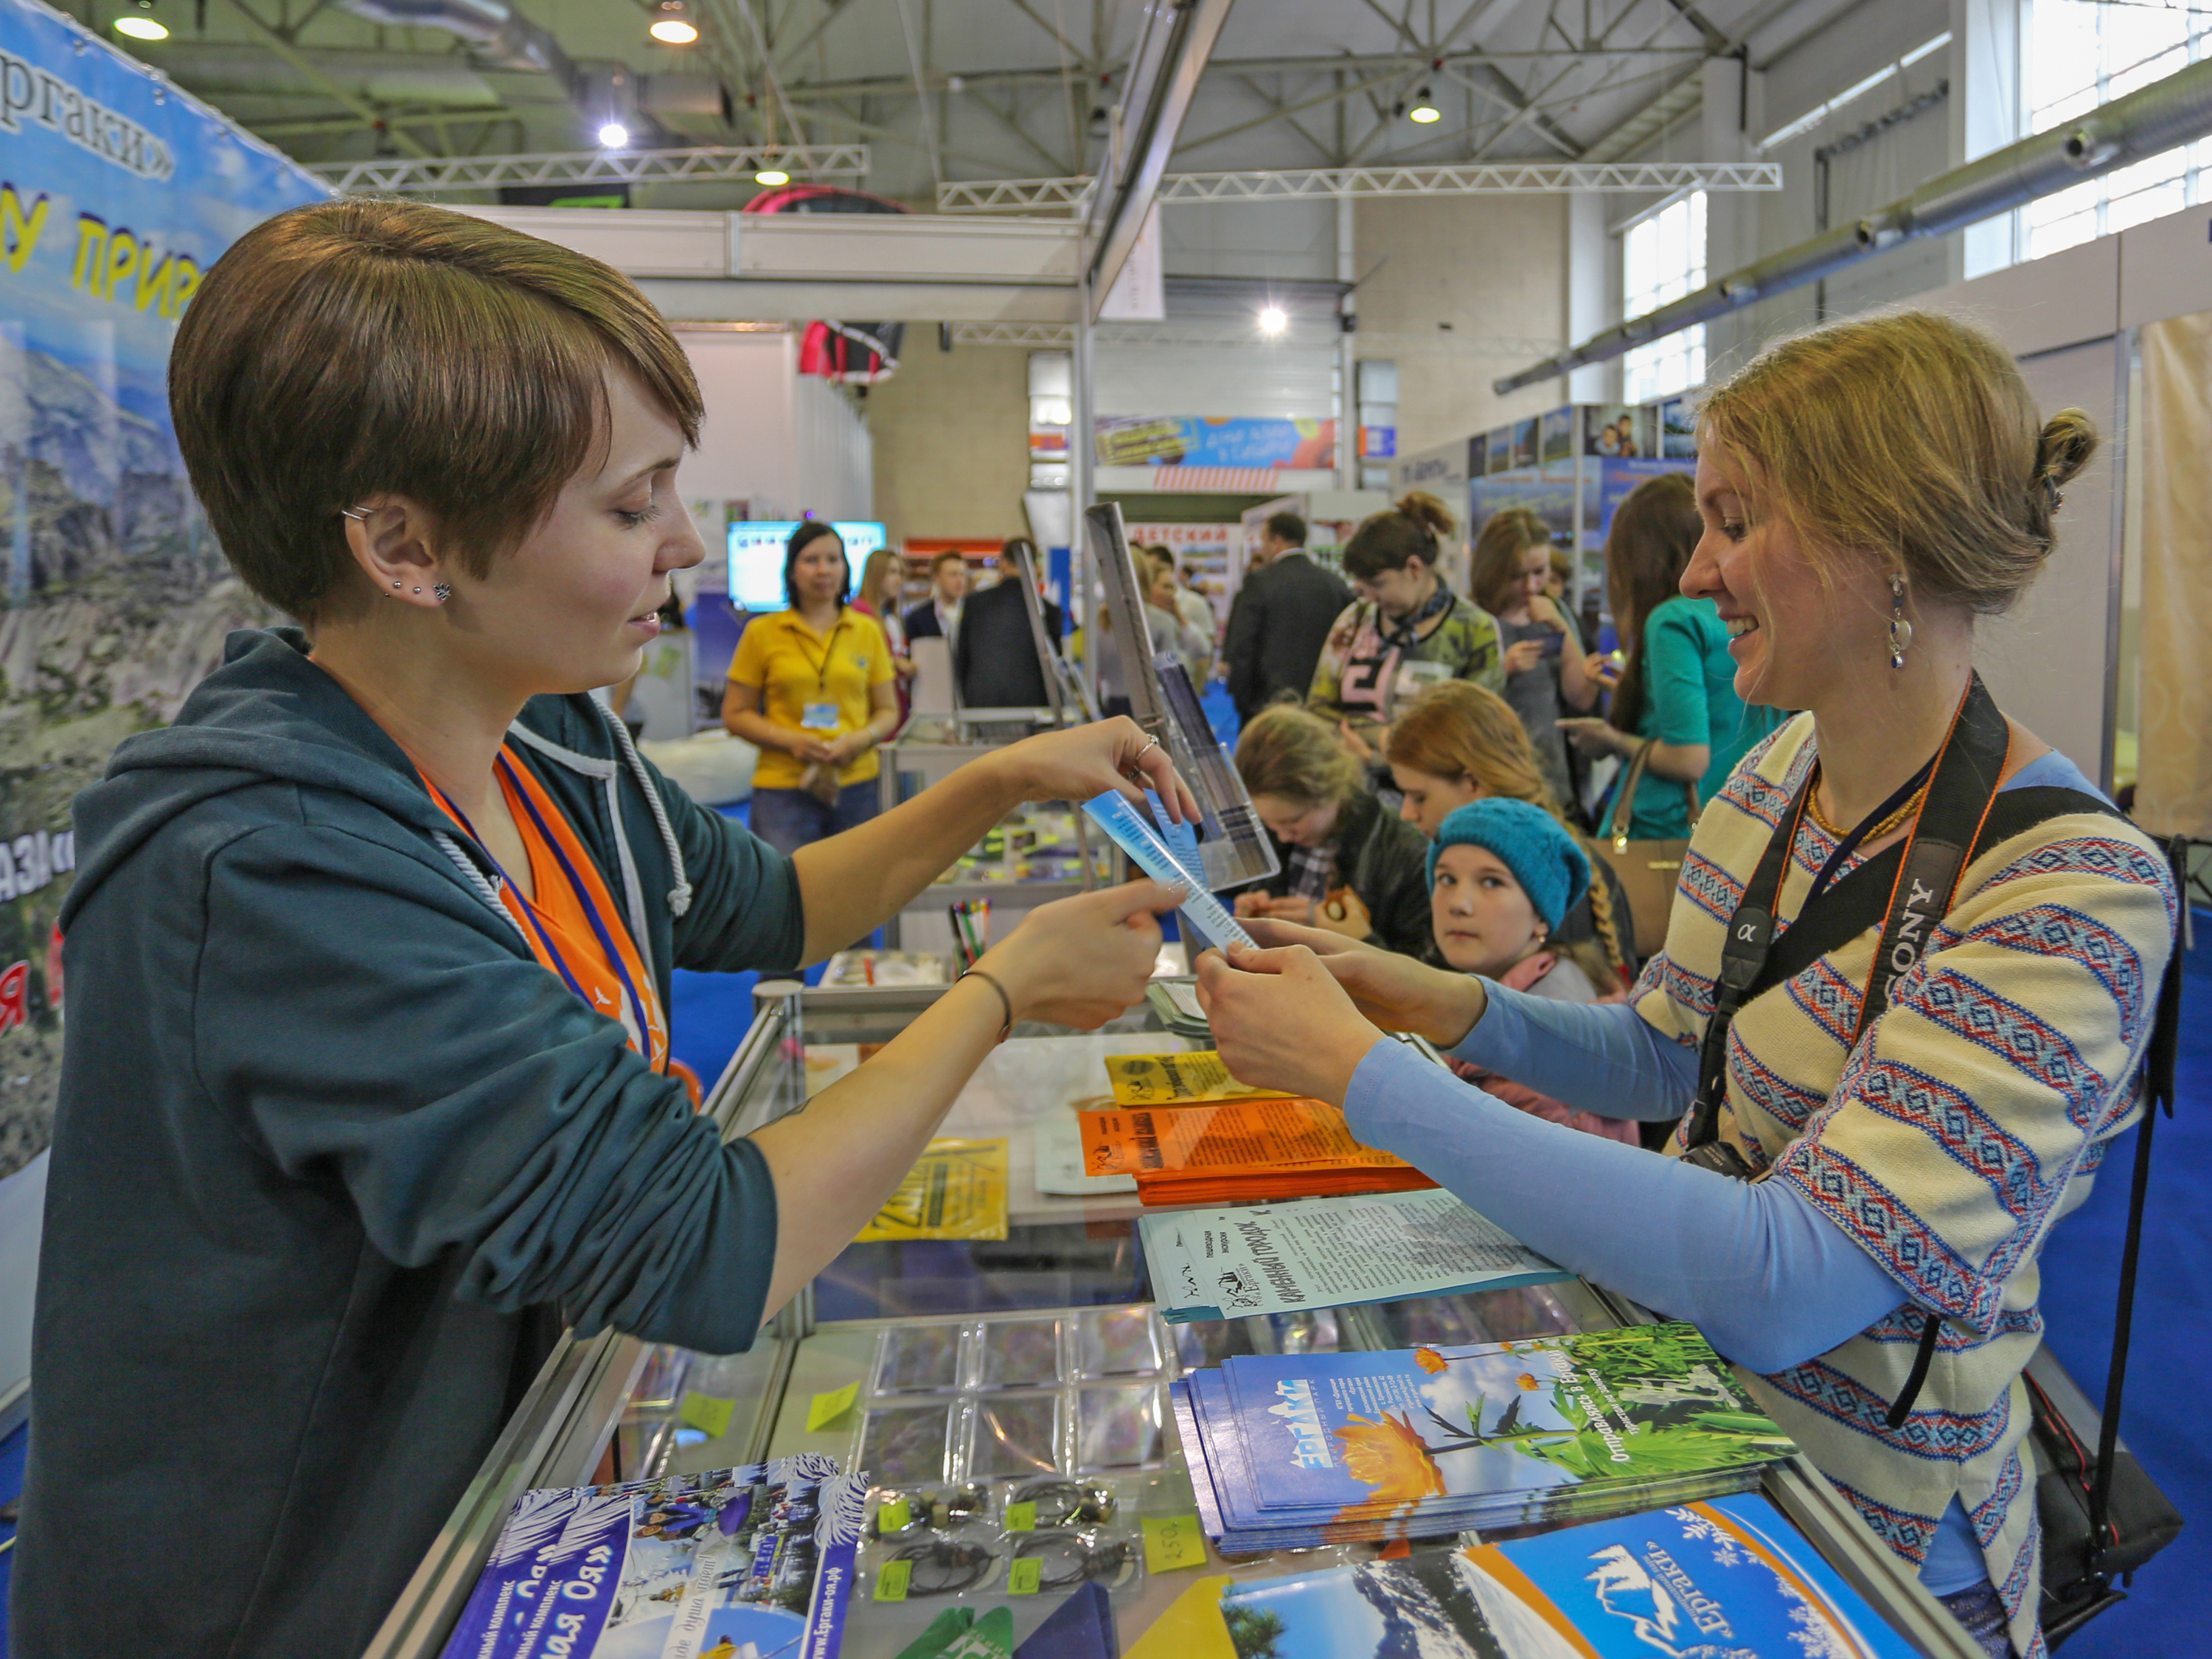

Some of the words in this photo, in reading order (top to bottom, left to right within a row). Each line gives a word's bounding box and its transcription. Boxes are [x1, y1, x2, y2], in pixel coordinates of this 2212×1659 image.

[73, 212, 212, 319] ПРИР
[1133, 524, 1227, 543] ДЕТСКИЙ
[1204, 1231, 1214, 1258] пешеходная
[1234, 1221, 1279, 1255] ГОРОДОК
[1251, 1256, 1306, 1304] КАМЕННЫЙ
[1309, 1378, 1321, 1403] ПАРК
[1547, 1349, 1580, 1384] Ергаки
[1586, 1368, 1610, 1393] заметку
[1281, 1380, 1334, 1469] ЕРГАКИ
[1317, 1408, 1341, 1467] ПРИРОДНЫЙ
[1577, 1394, 1630, 1461] Отправляясь
[1611, 1404, 1640, 1436] туристам
[562, 1545, 613, 1600] Оя»
[1646, 1541, 1733, 1638] «Ергаки»
[489, 1580, 515, 1629] комплекс
[529, 1579, 563, 1629] комплекс
[675, 1598, 706, 1632] душа
